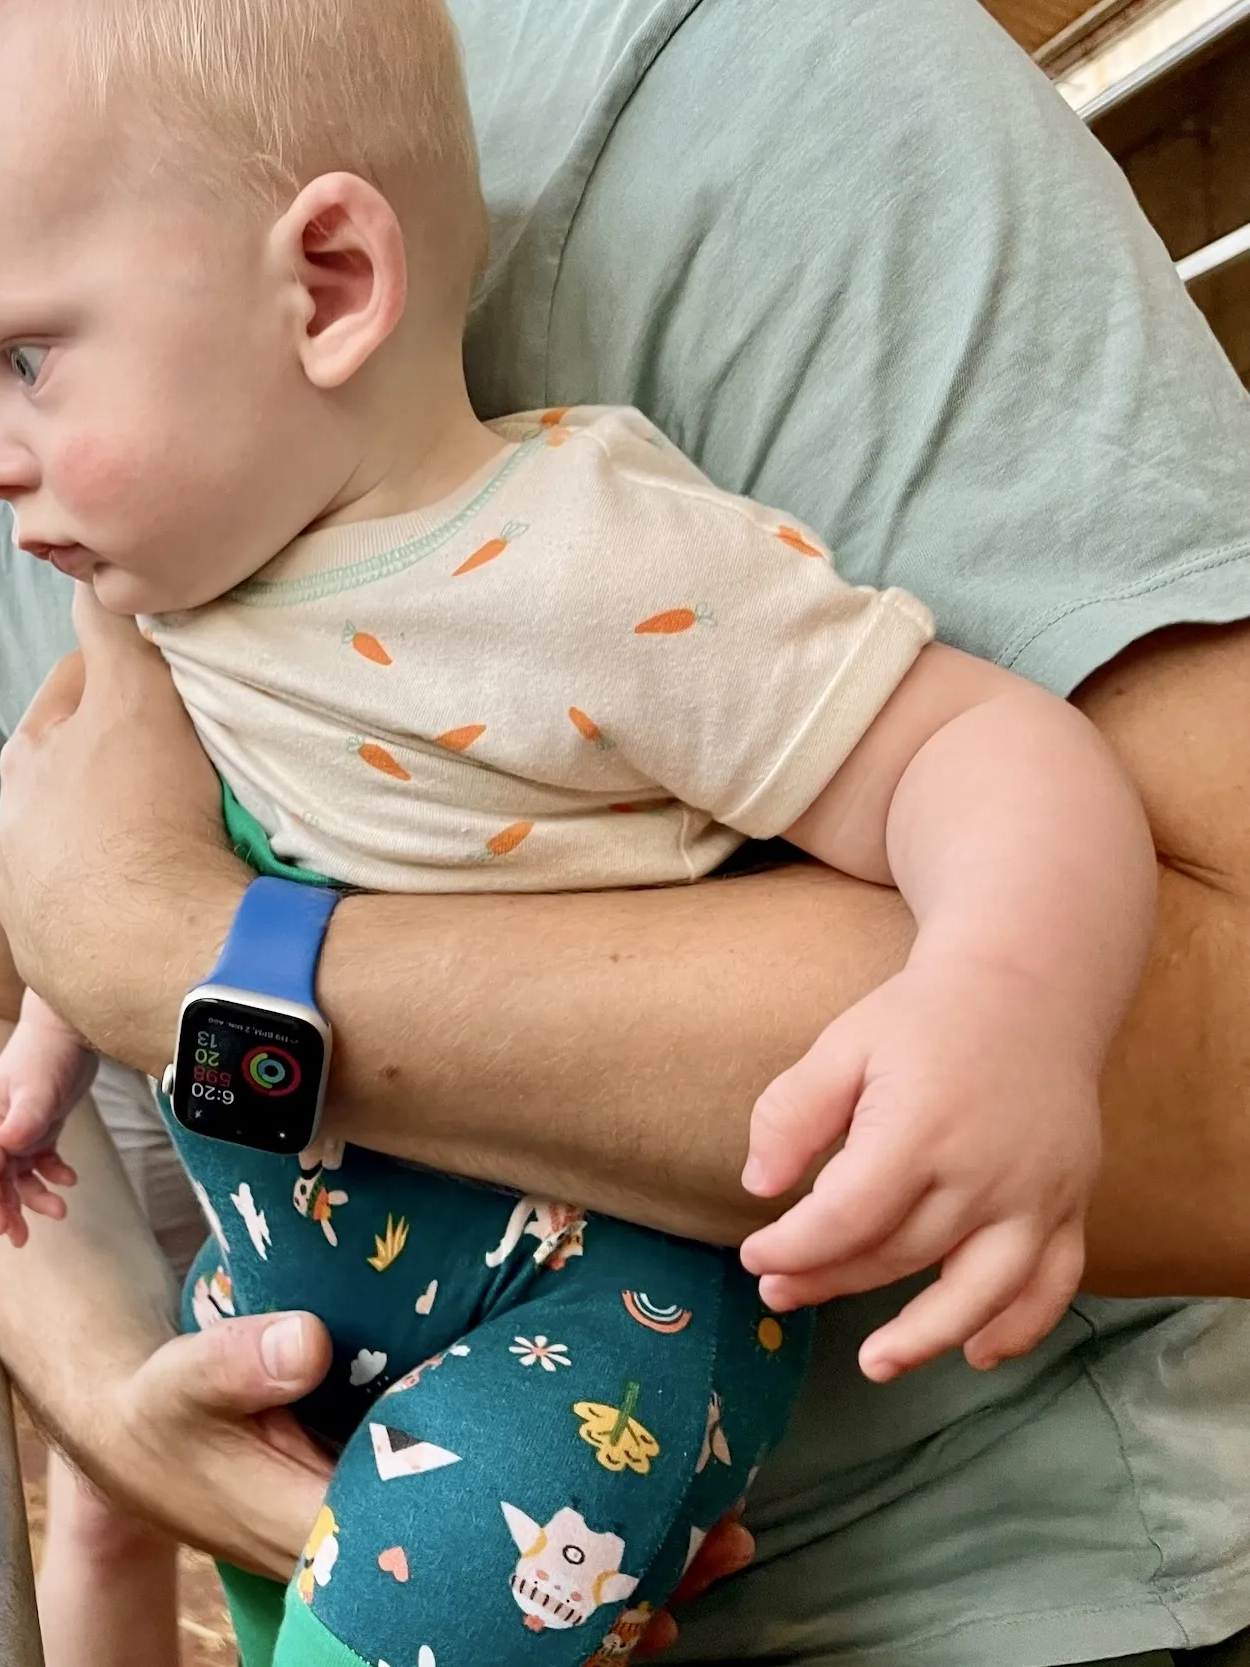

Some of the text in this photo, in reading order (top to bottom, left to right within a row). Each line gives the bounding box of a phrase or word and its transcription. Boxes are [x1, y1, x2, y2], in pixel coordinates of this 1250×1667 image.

[197, 1031, 218, 1048] 13
[194, 1049, 220, 1067] 20
[193, 1065, 232, 1088] 598
[191, 1082, 235, 1105] 6:20
